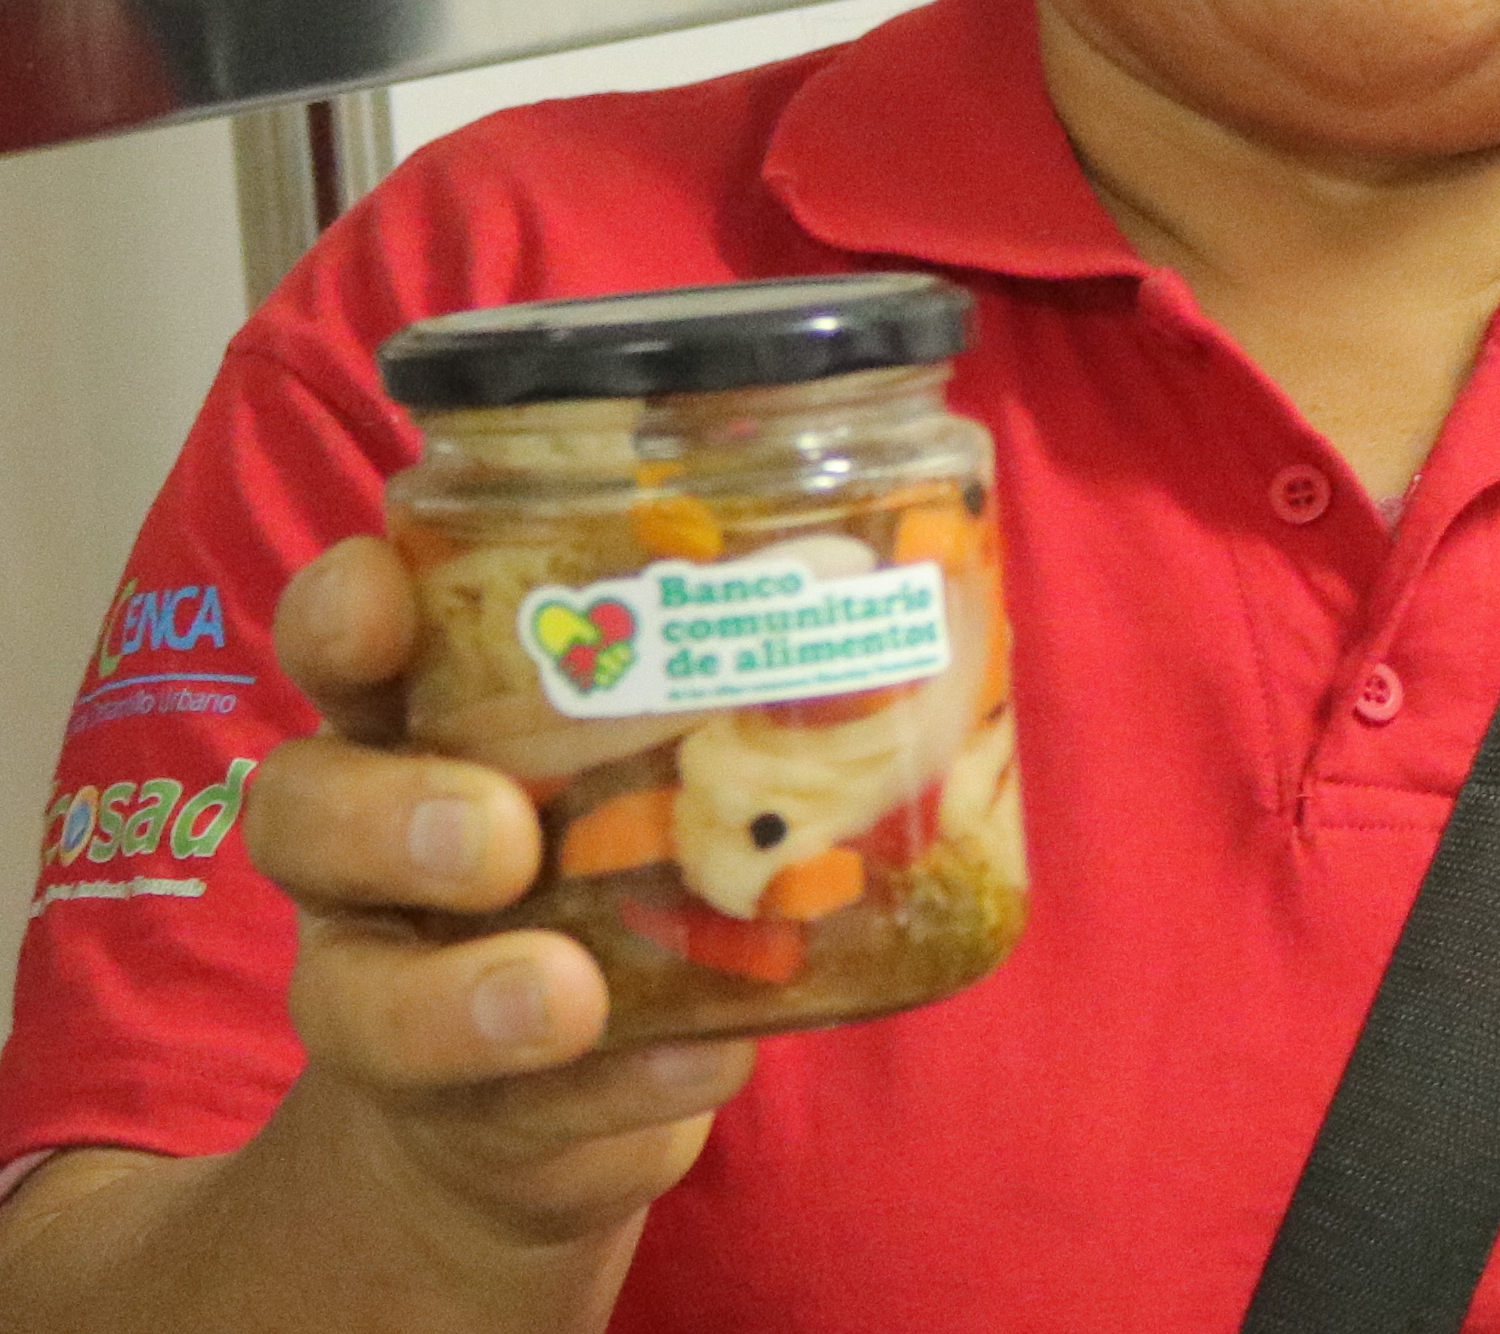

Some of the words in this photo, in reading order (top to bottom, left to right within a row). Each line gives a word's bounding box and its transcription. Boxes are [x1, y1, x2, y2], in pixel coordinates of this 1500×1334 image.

[661, 573, 802, 607] Banco
[663, 581, 932, 643] comunitario
[666, 647, 719, 677] de
[736, 621, 937, 672] alimentos
